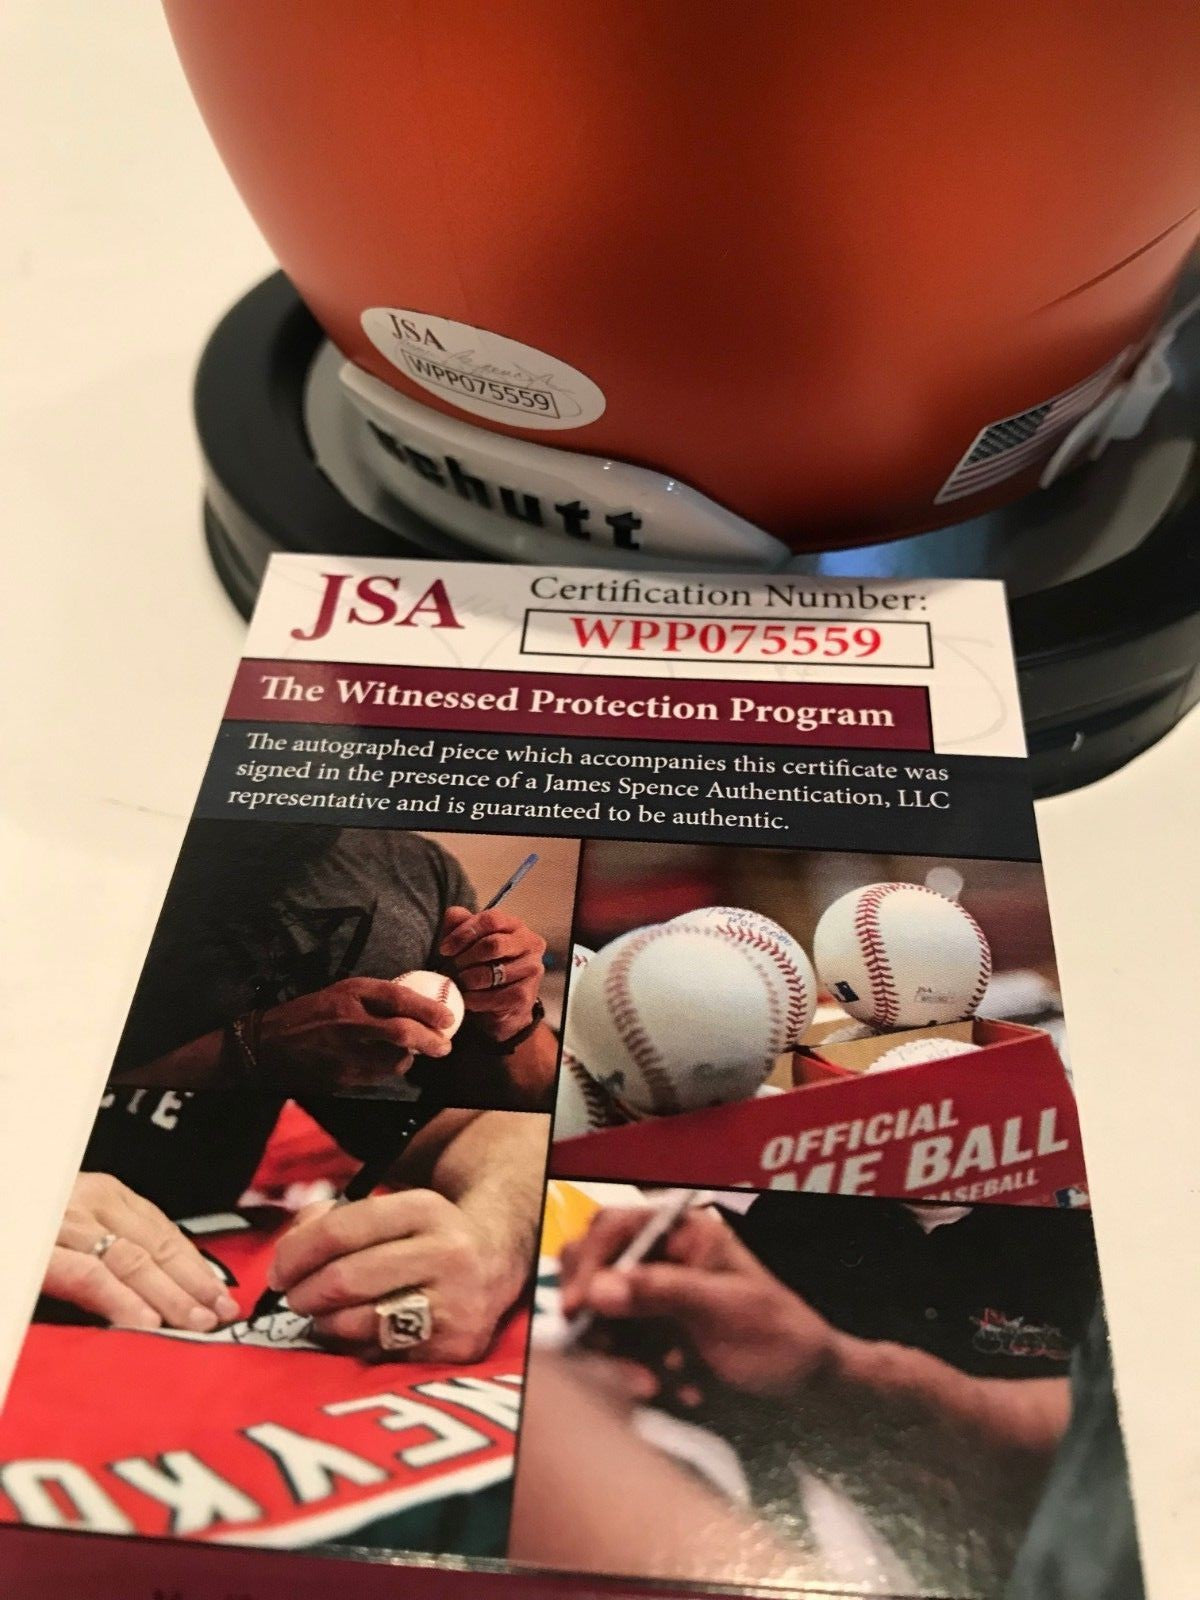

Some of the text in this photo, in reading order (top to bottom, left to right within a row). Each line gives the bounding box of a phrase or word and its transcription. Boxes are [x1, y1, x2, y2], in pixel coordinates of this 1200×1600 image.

[388, 314, 446, 351] JSA
[408, 352, 551, 411] WPP075559
[291, 574, 466, 640] JSA
[531, 575, 928, 611] Certification Number:
[569, 616, 883, 658] WPP075559
[262, 676, 894, 731] The Witnessed Protection Program
[248, 733, 948, 780] The autographed piece which accompanies this certificate was
[237, 761, 949, 808] signed in the presence of a James Spence Authentication, LLC
[228, 790, 788, 829] representative and is guaranteed to be authentic.
[731, 1108, 1069, 1197] ME BALL
[761, 1099, 959, 1170] OFFICIAL
